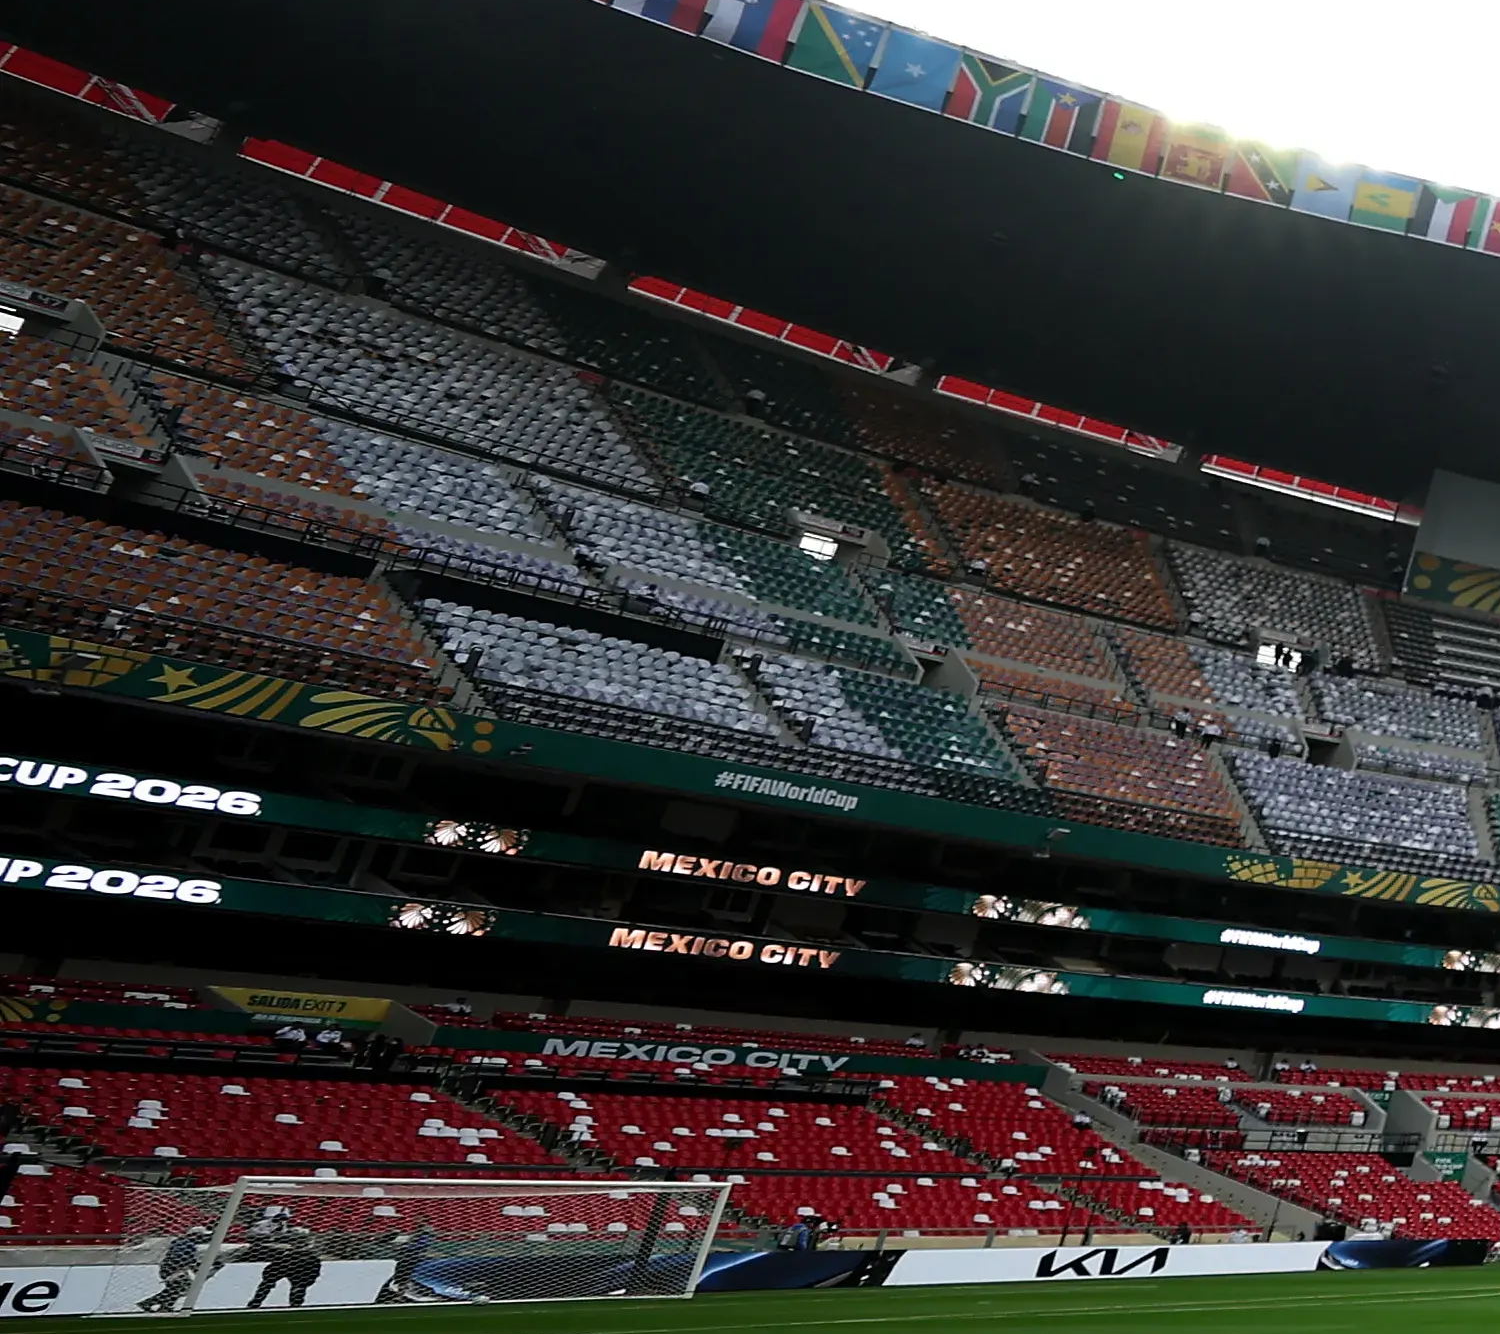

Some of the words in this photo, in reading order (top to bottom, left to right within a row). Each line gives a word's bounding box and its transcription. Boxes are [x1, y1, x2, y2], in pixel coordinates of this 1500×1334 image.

[715, 771, 858, 811] #FIFAWorldCup
[0, 857, 43, 883] P
[45, 865, 222, 905] 2026
[638, 849, 781, 886] MEXICO
[787, 871, 868, 897] CITY
[608, 927, 754, 960] MEXICO
[760, 944, 842, 969] CITY
[302, 1000, 335, 1012] EXIT
[541, 1038, 736, 1065] MEXICO
[745, 1051, 850, 1072] CITY
[1035, 1247, 1169, 1277] KIA
[0, 1281, 59, 1313] e
